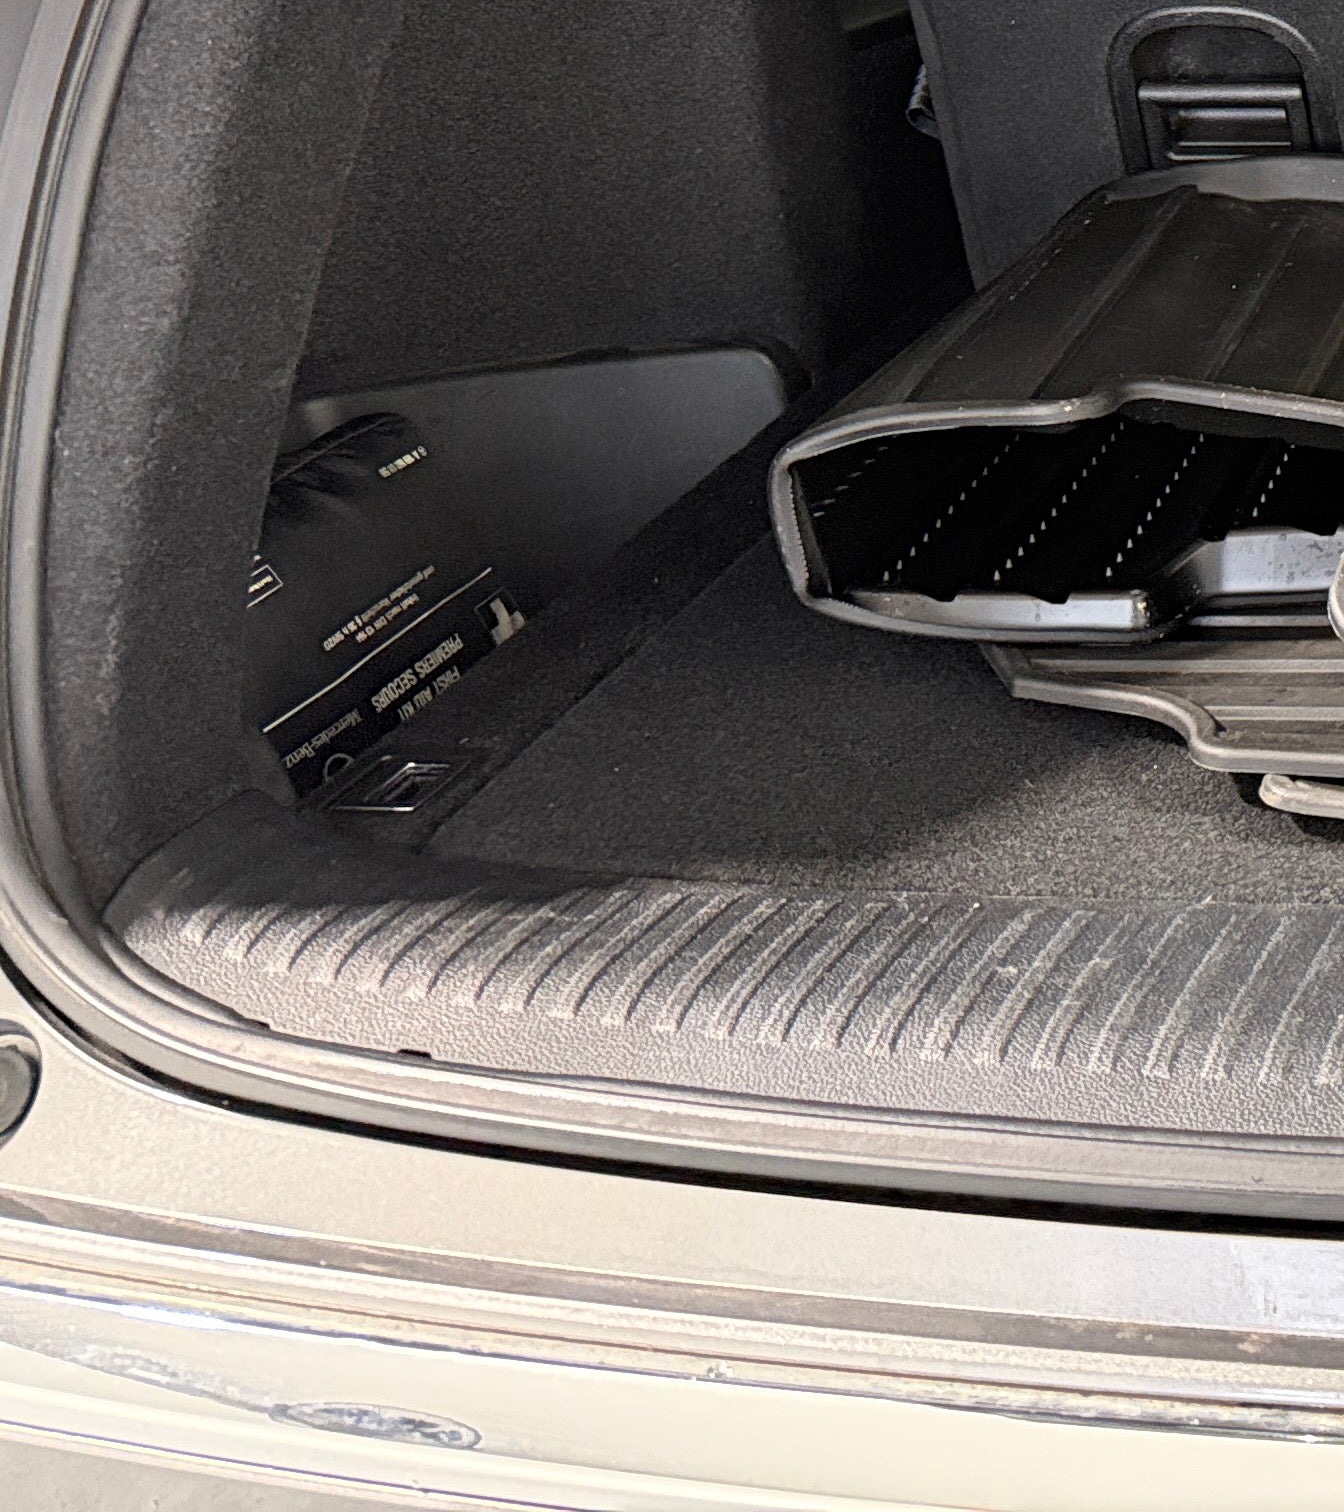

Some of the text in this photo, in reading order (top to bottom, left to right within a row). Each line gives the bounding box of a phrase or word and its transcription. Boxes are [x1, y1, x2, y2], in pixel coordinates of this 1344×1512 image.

[371, 633, 464, 713] PREMIERS SECOURS
[432, 665, 461, 695] FIRST
[398, 701, 415, 721] KIT
[281, 708, 362, 768] Mercedes-Benz
